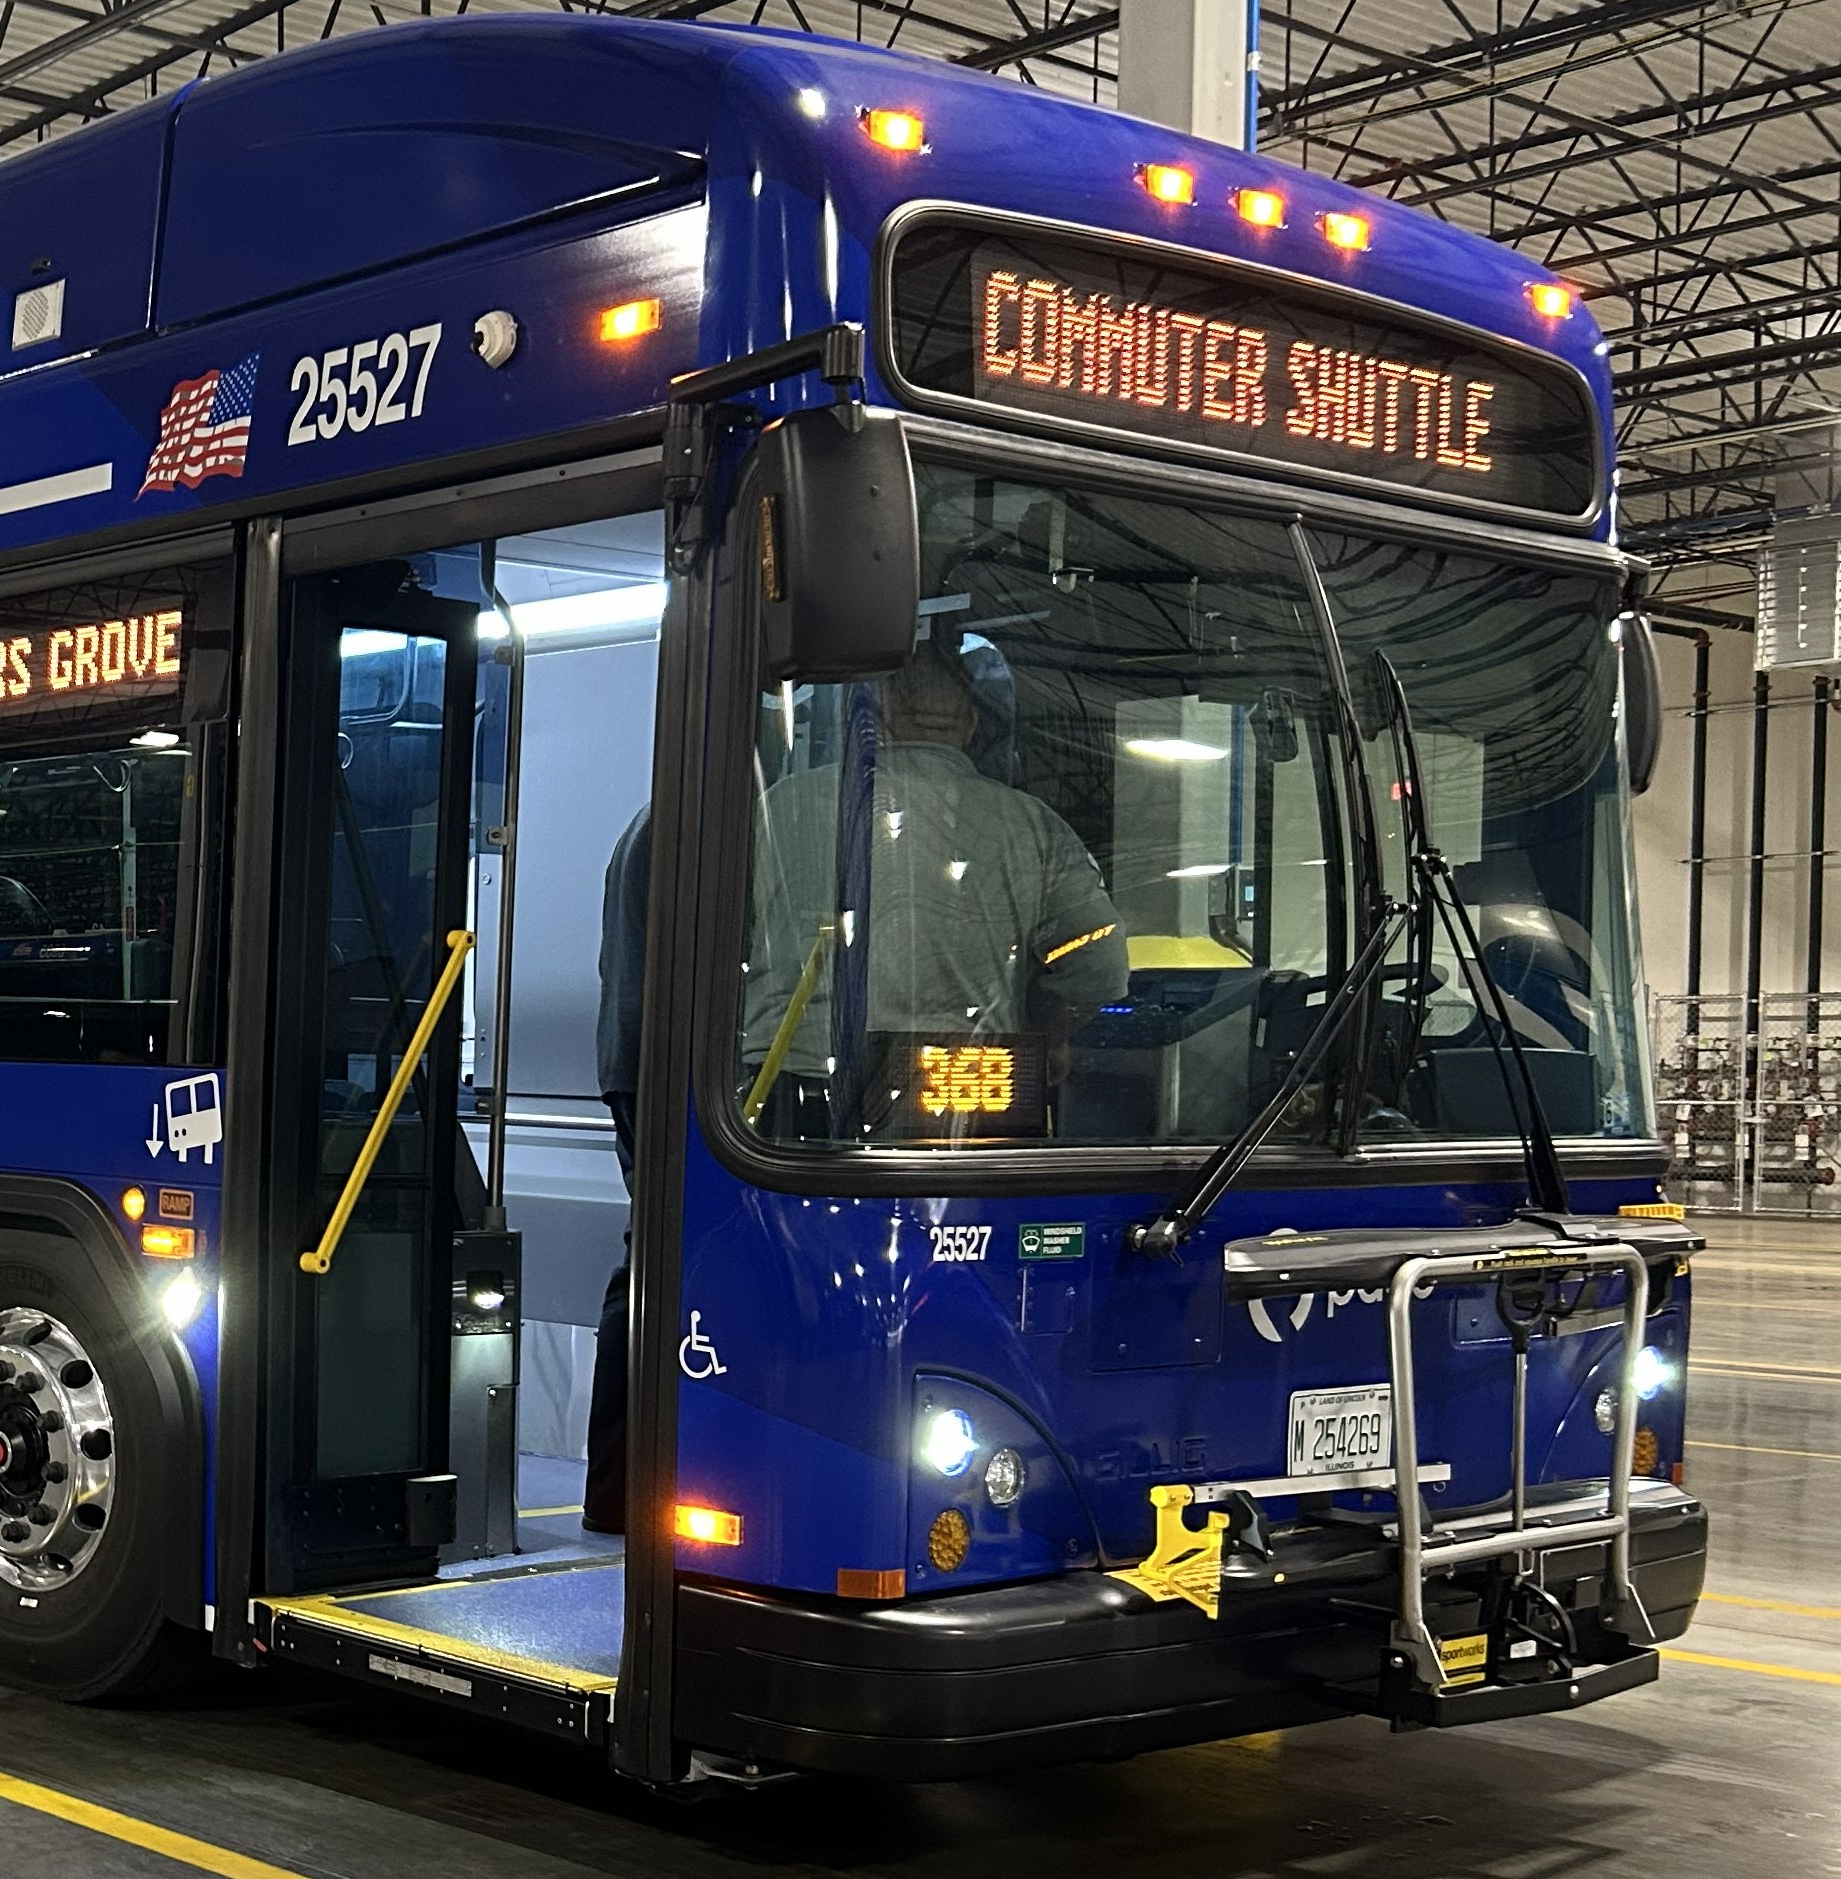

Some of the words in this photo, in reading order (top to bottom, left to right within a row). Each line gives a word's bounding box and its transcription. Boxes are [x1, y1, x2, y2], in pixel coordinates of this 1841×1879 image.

[287, 322, 442, 447] 25527
[982, 270, 1269, 427] COMMUTER
[1284, 340, 1495, 473] SHUTTLE
[48, 610, 184, 692] GROVE
[162, 1194, 191, 1213] RAMP
[929, 1225, 993, 1262] 25527
[1293, 1418, 1305, 1463] M
[1313, 1413, 1381, 1461] 254269
[1325, 1460, 1355, 1472] ILLINOIS
